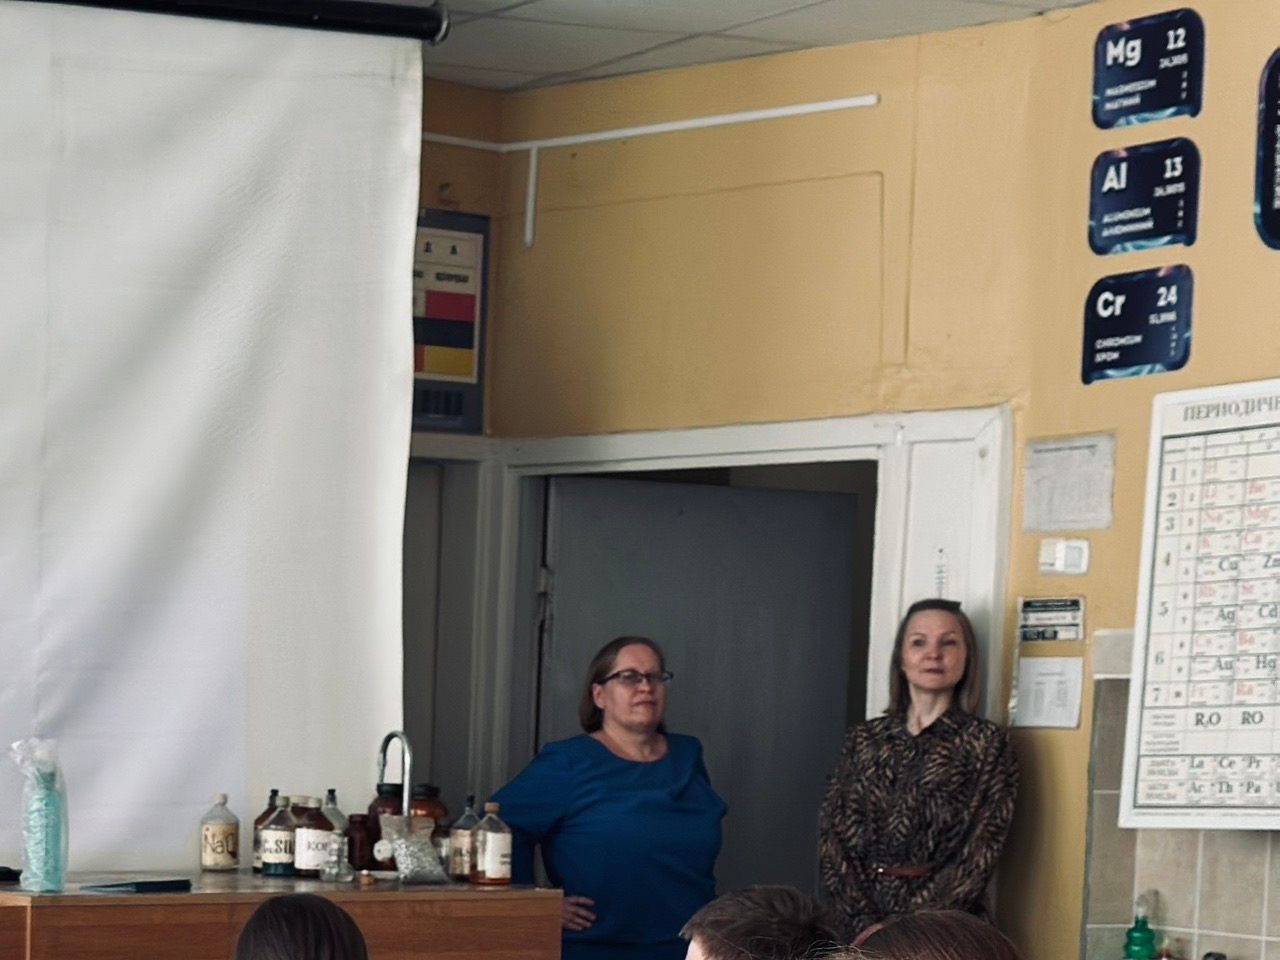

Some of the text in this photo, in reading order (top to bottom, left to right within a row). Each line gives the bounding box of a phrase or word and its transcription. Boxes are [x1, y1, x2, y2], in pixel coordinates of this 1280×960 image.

[1166, 27, 1187, 50] 12
[1106, 37, 1142, 67] Mg
[1102, 161, 1128, 192] Al
[1163, 156, 1183, 179] 13
[1096, 291, 1126, 318] Cr
[1156, 285, 1178, 307] 24
